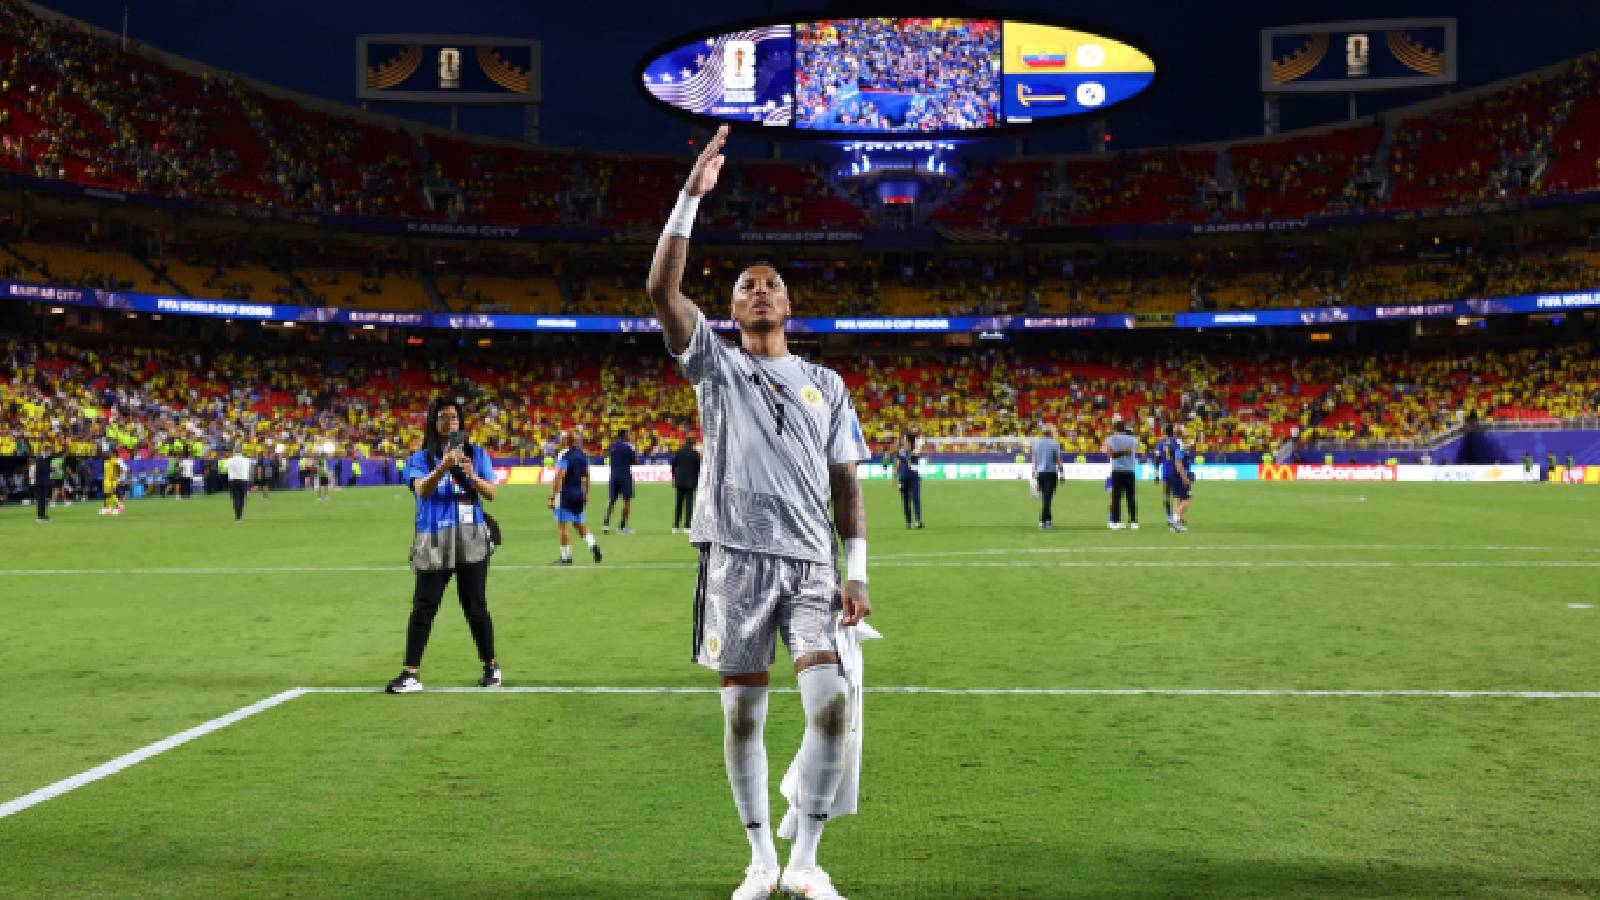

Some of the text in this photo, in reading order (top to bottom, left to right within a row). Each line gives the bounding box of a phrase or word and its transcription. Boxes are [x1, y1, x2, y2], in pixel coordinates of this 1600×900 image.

[407, 224, 519, 237] KANSAS CITY
[1193, 217, 1309, 232] KANSAS CITY
[741, 232, 763, 241] FIFA
[765, 232, 802, 241] WORLD
